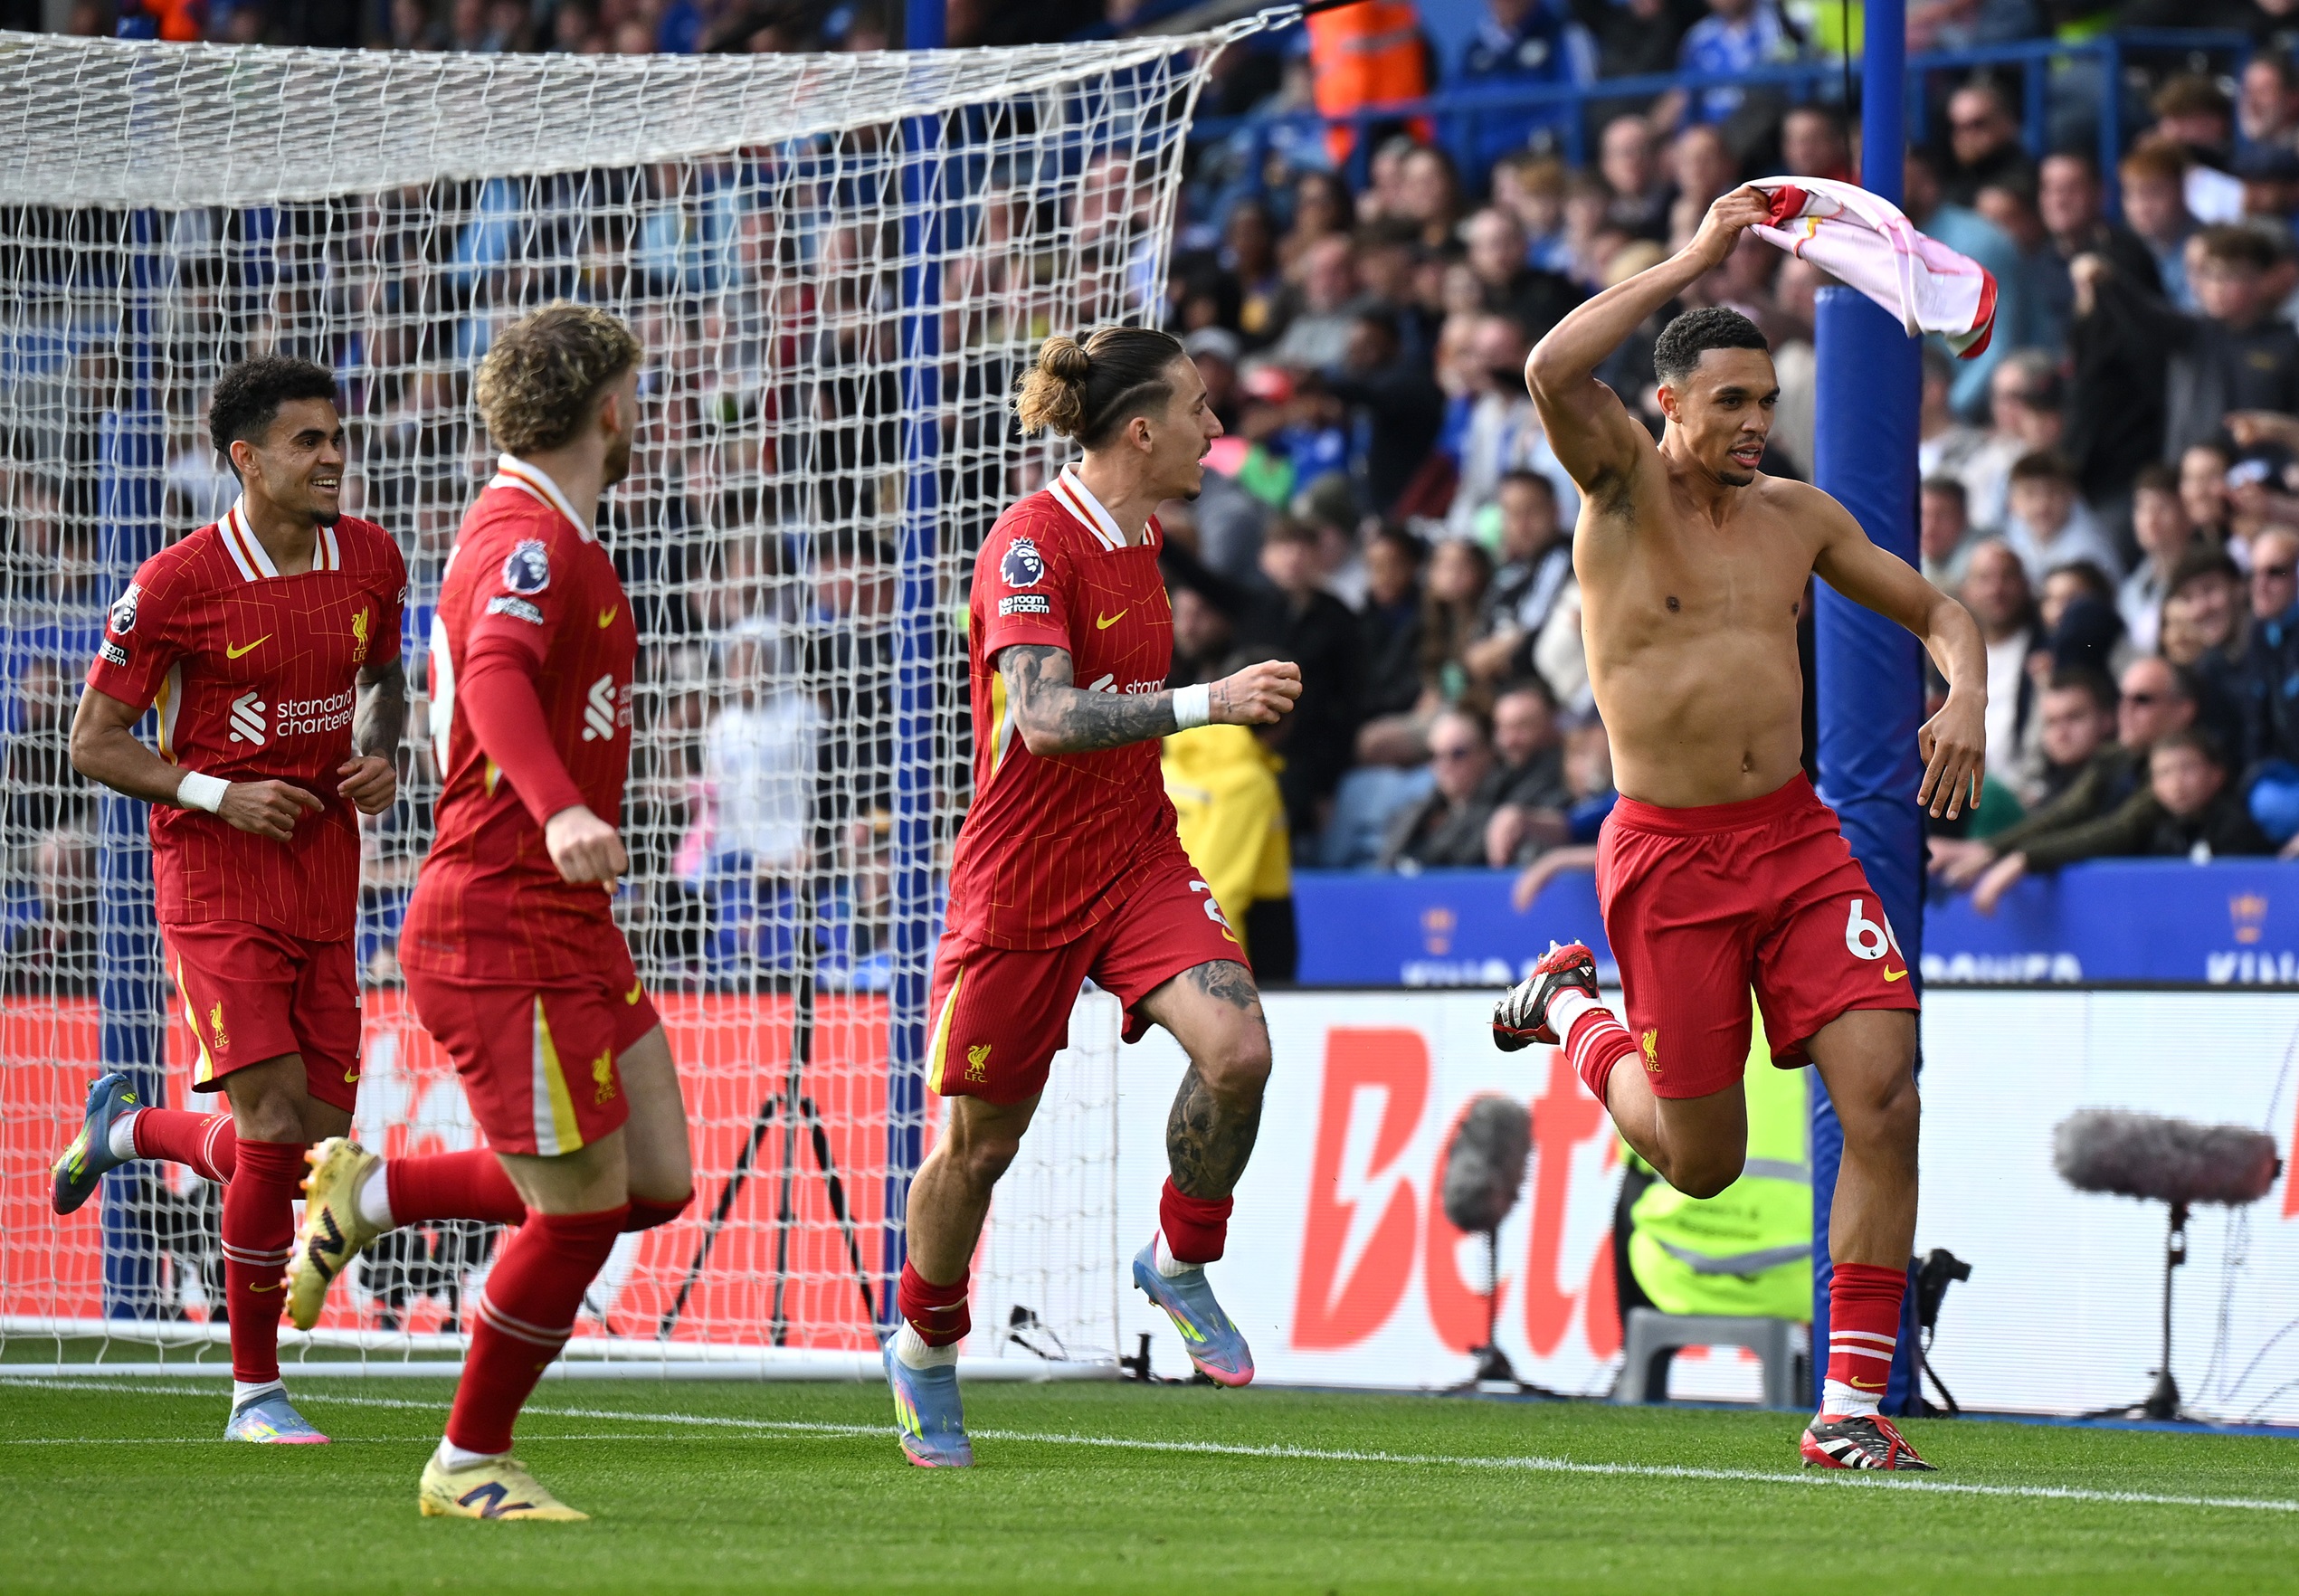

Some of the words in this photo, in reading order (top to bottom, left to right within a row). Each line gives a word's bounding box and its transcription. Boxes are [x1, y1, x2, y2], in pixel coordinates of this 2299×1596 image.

[1014, 595, 1045, 604] room
[276, 701, 355, 737] chartered
[1846, 898, 1905, 961] 6
[2206, 952, 2299, 985] KIN
